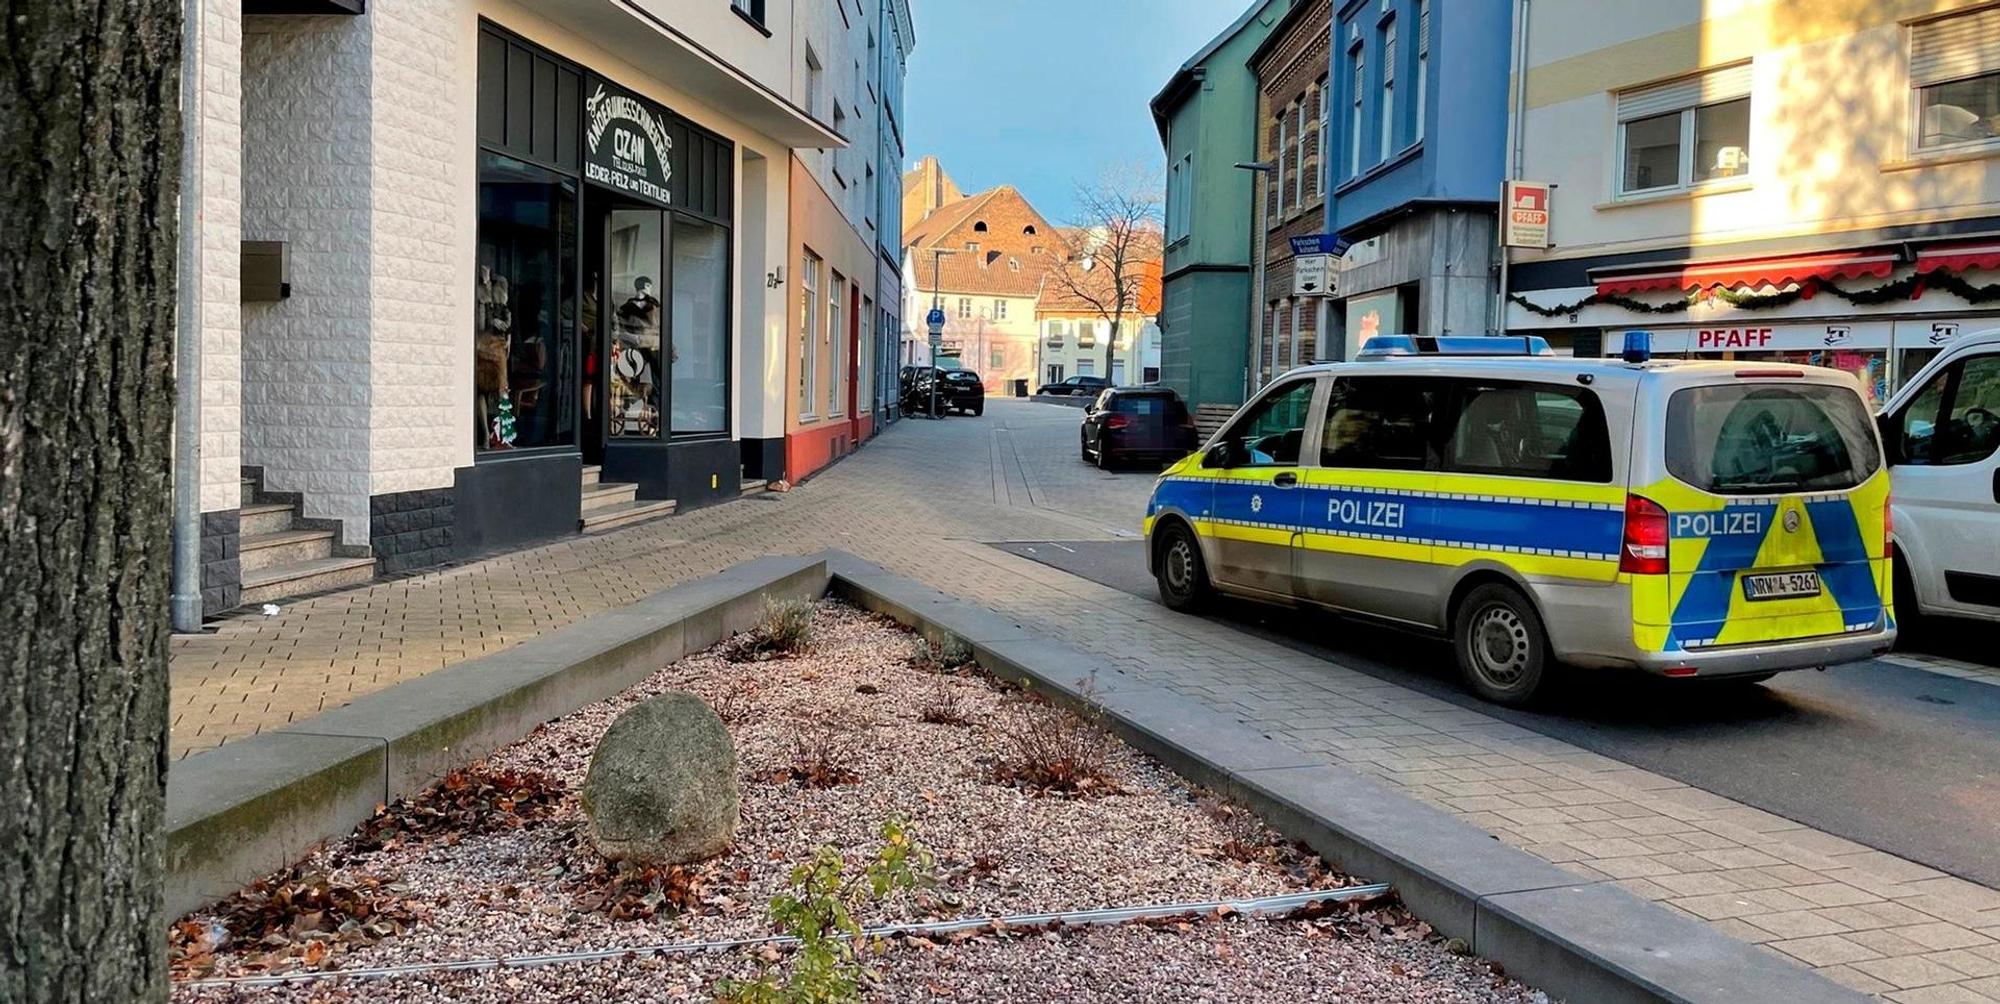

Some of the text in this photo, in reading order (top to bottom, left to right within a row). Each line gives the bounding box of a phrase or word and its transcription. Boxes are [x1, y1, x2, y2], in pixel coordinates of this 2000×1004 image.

[614, 128, 645, 166] OZAN
[639, 179, 671, 204] TEXTILIEN
[1516, 212, 1543, 223] PFAFF
[932, 311, 940, 321] P
[1699, 329, 1772, 347] PFAFF
[1327, 498, 1404, 528] POLIZEI
[1676, 512, 1761, 536] POLIZEI
[1752, 577, 1773, 595] NRW
